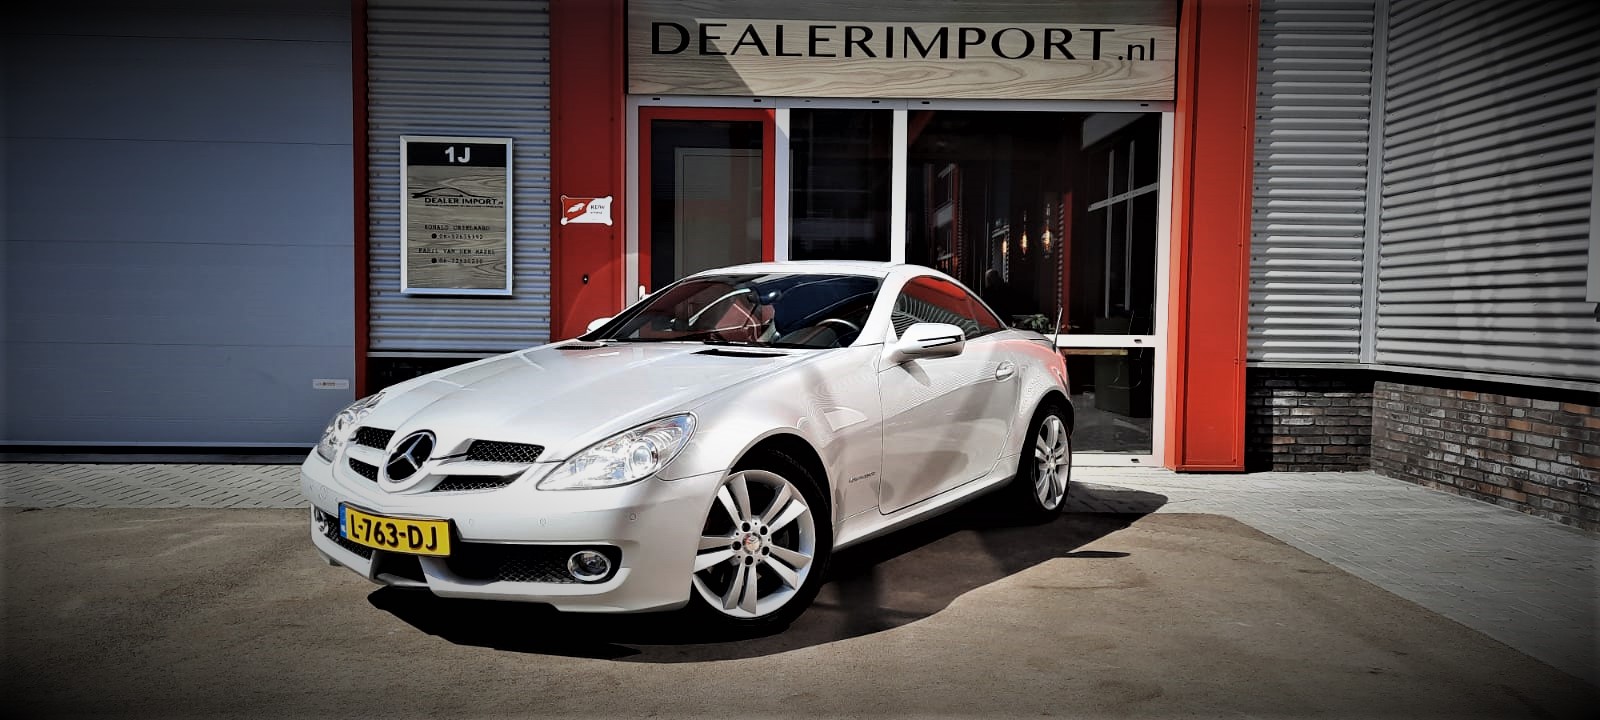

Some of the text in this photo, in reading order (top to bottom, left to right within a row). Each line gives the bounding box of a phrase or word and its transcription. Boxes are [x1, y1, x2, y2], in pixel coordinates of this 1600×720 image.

[651, 21, 1155, 62] DEALERIMPORT.nl
[444, 146, 471, 163] 1J
[351, 514, 437, 551] L-763-DJ
